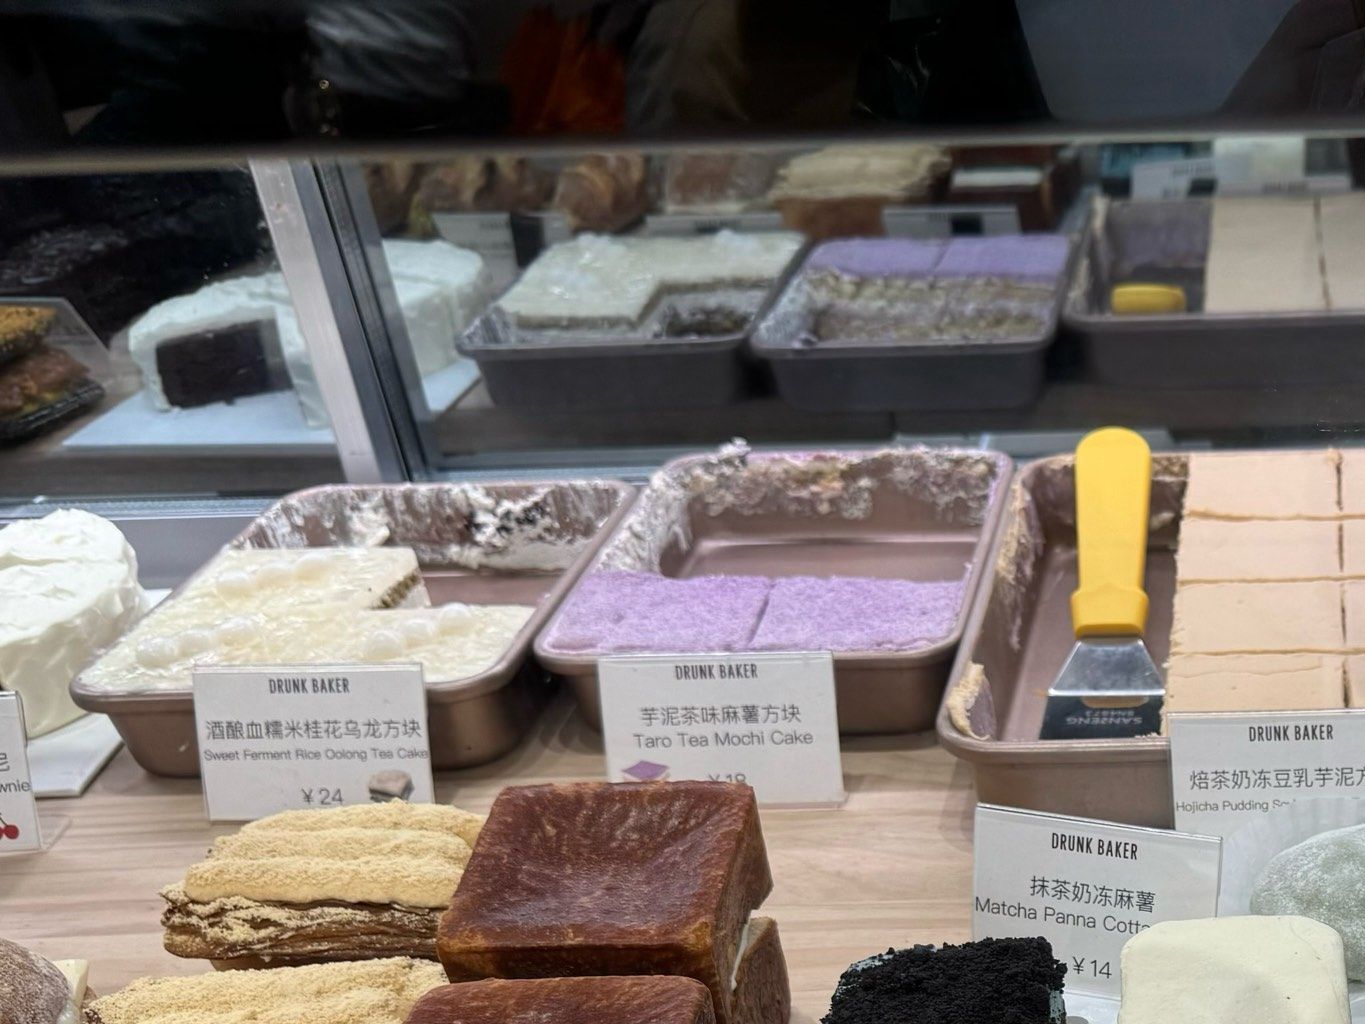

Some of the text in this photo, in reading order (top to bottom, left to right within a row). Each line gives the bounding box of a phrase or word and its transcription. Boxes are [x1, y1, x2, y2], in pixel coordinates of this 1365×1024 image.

[675, 663, 758, 680] DRUNK BAKER
[268, 677, 350, 694] DRUNK BAKER
[640, 704, 802, 727] 芋泥茶味麻薯方块
[206, 718, 422, 741] 酒酿血糯米桂花乌龙方块
[1249, 724, 1333, 742] DRUNK BAKER
[634, 730, 813, 749] Taro Tea Mochi Cake
[205, 748, 429, 762] Sweet Ferment Rice Oolong Tea Cake
[1176, 800, 1219, 814] Hojicha
[1223, 800, 1269, 813] Pudding
[1051, 832, 1138, 860] DRUNK BAKER
[1030, 875, 1156, 913] 抹茶奶冻麻薯
[975, 896, 1037, 920] Matcha
[1044, 906, 1096, 929] Panna
